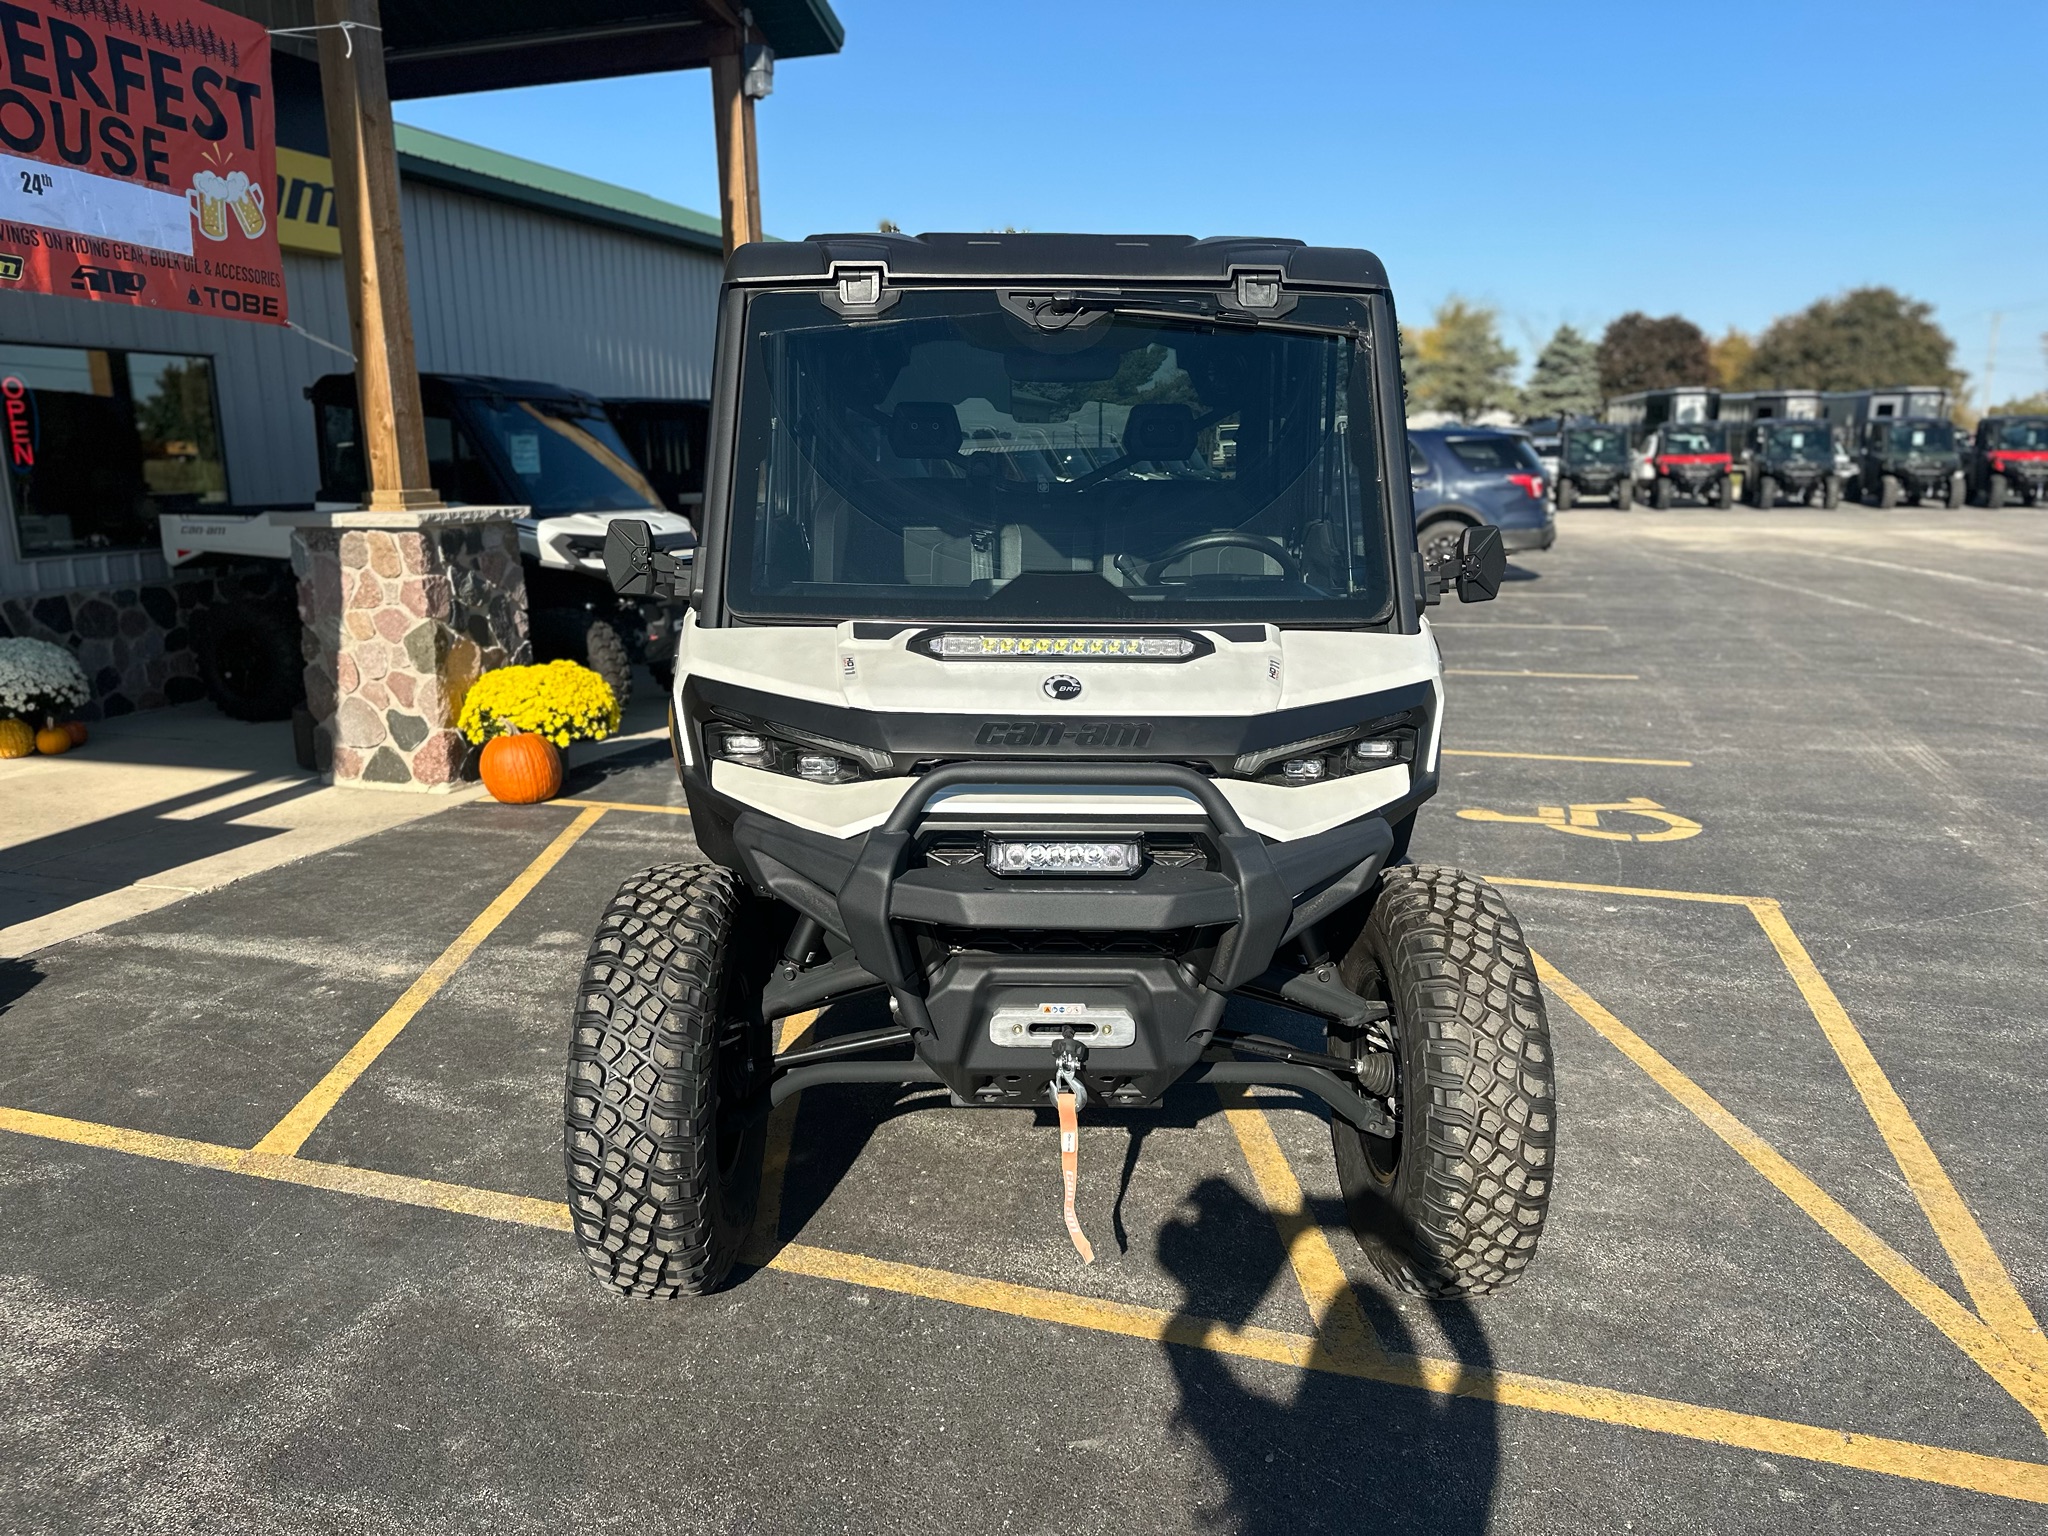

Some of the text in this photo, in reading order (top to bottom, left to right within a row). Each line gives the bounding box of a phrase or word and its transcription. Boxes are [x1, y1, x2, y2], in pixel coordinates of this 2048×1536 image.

[0, 2, 262, 151] ERFEST
[20, 171, 53, 195] 24th
[42, 231, 62, 251] ON
[66, 236, 110, 258] RIDING
[113, 243, 147, 267] GEAR,
[150, 249, 181, 270] BULK
[183, 256, 202, 274] OIL
[204, 260, 212, 276] &
[215, 262, 280, 288] ACCESSORIES
[203, 286, 279, 317] TOBE
[1, 376, 34, 465] OPEN
